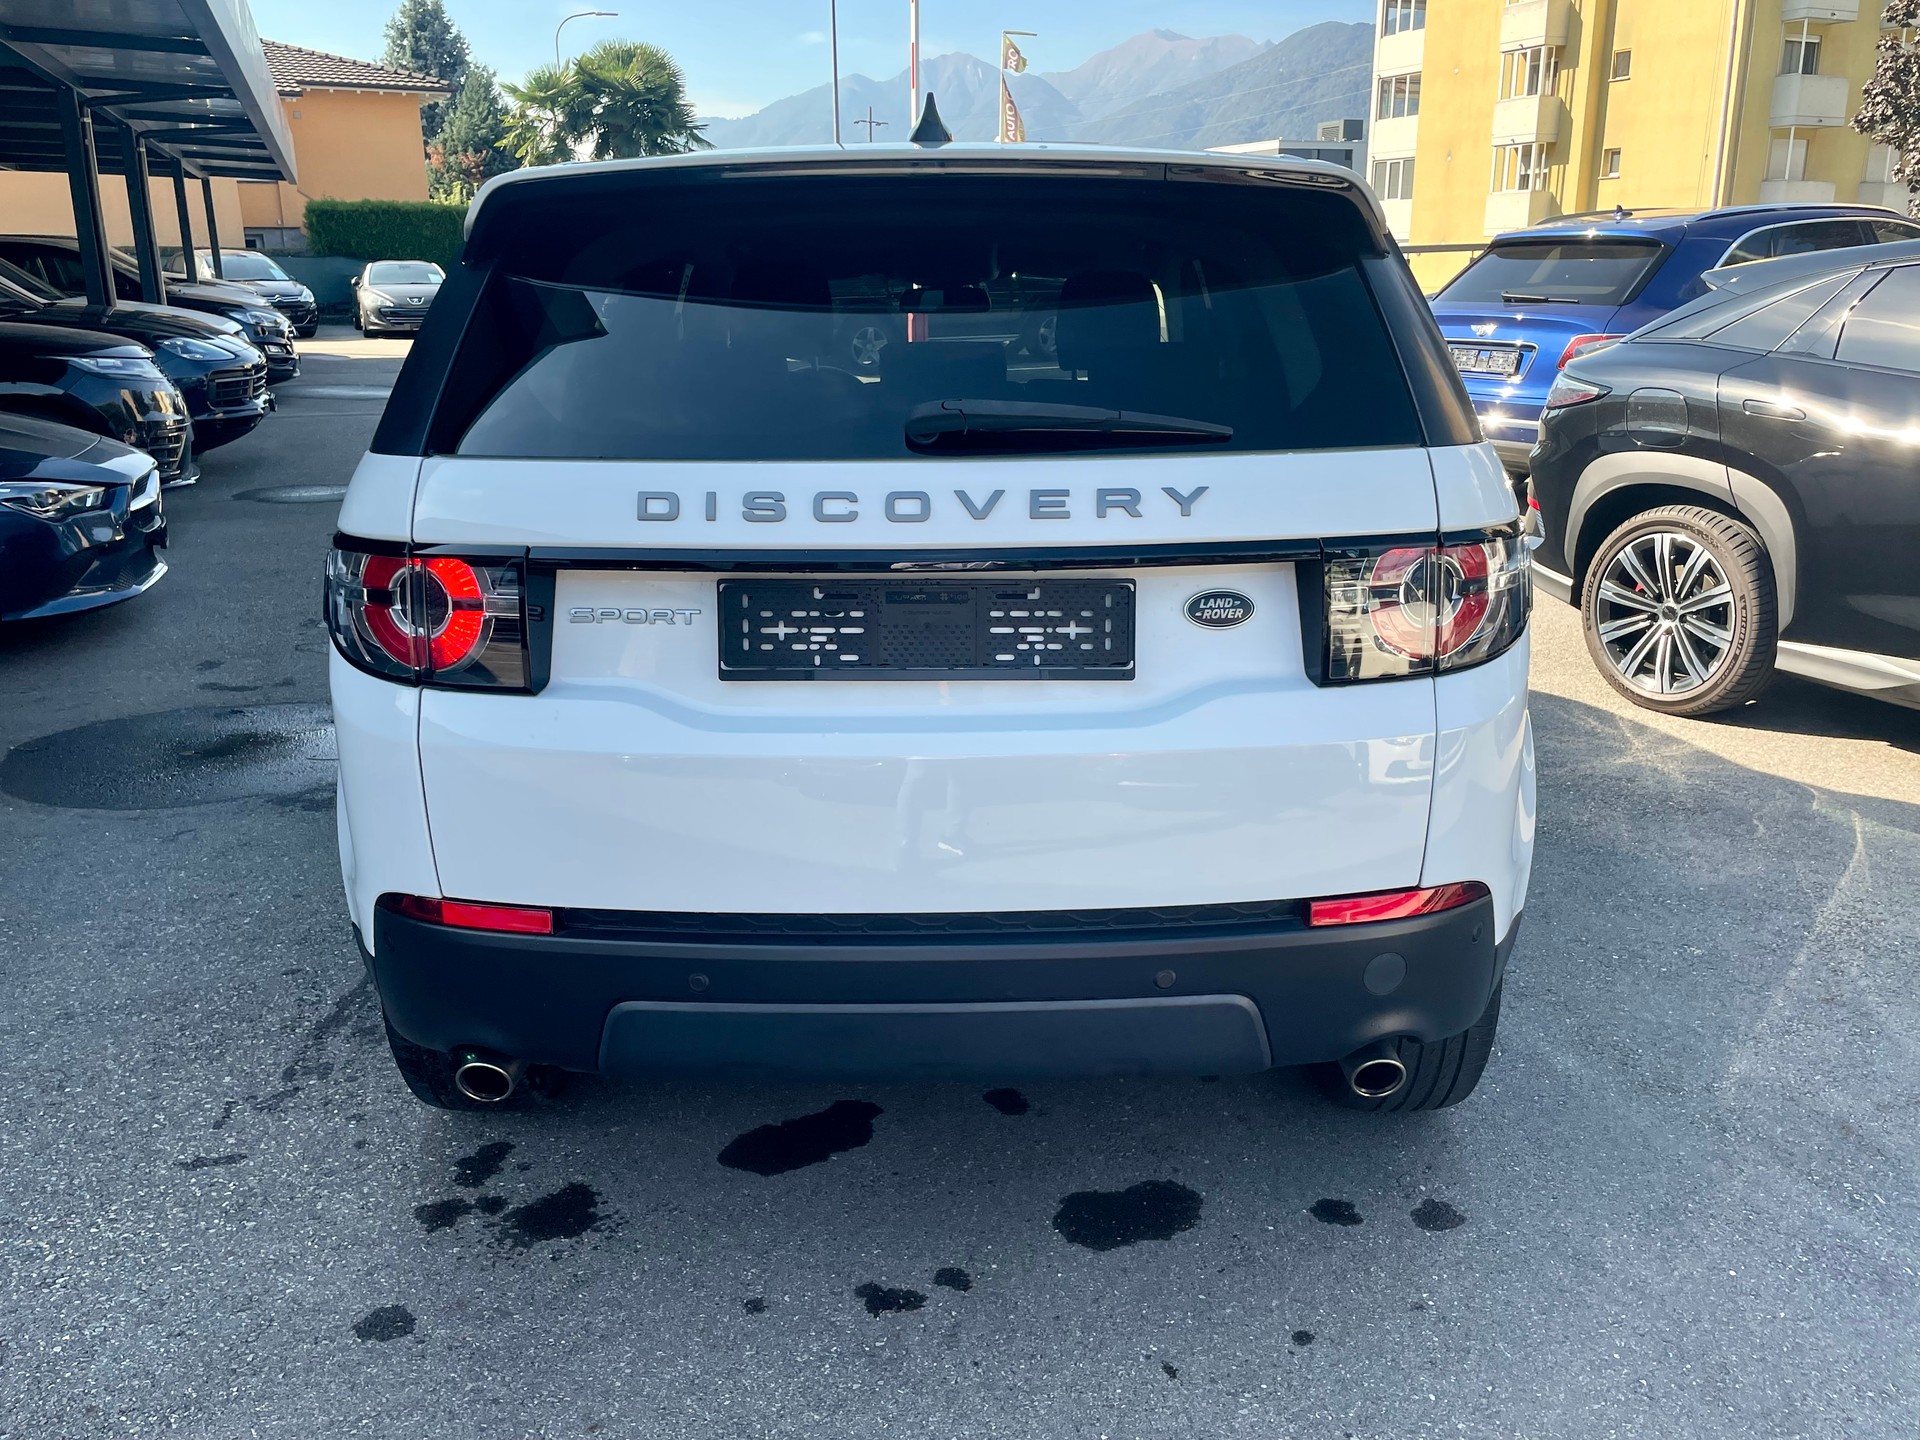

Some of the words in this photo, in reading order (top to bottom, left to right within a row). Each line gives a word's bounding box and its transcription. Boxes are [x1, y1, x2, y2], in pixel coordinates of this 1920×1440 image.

[1005, 103, 1016, 141] AUTO
[637, 486, 1210, 523] DISCOVERY
[1199, 598, 1233, 609] LAND
[569, 607, 702, 625] SPORT
[1202, 608, 1244, 619] ROVER
